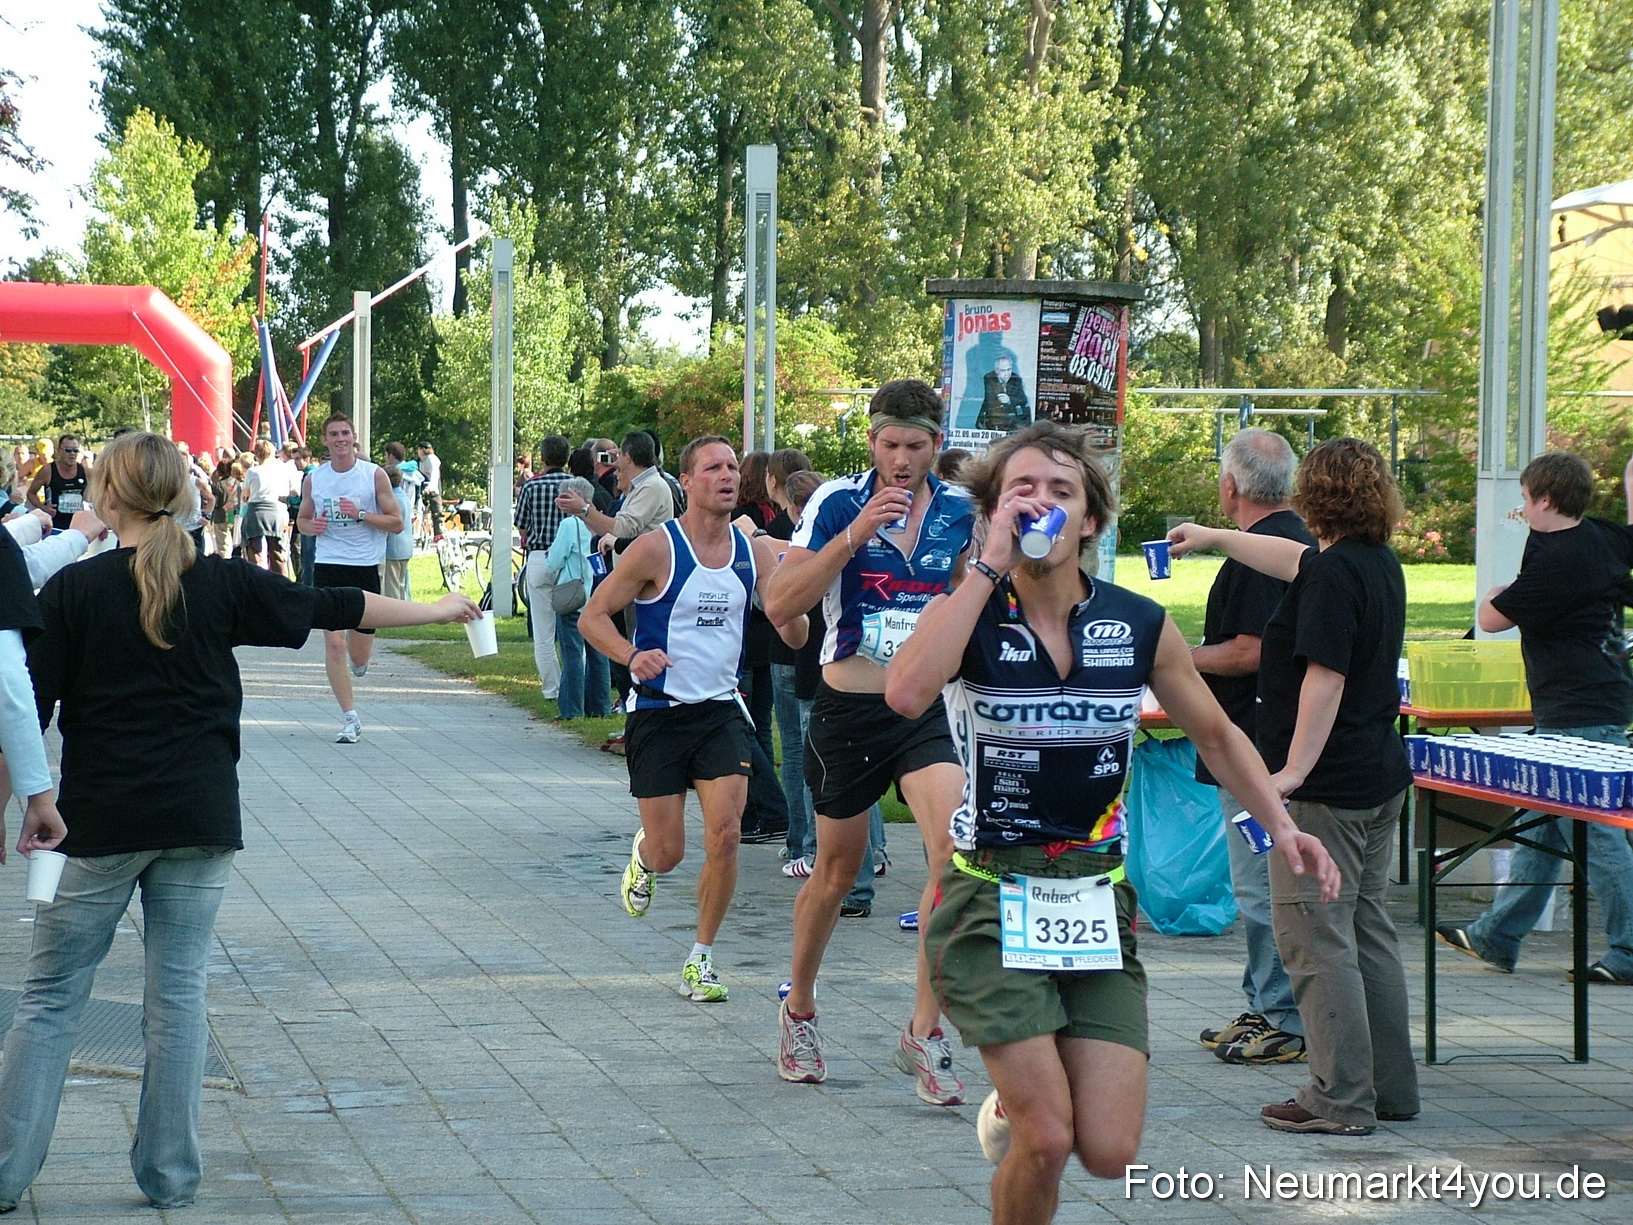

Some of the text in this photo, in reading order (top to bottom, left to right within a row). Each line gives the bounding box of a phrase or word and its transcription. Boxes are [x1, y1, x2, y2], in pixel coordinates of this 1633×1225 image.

[964, 304, 993, 317] Bruno
[957, 312, 1013, 342] Jonas
[1069, 353, 1116, 392] 08.09.07
[718, 592, 730, 600] LINE
[696, 616, 726, 627] PowerBar
[885, 616, 917, 631] Manfre
[1083, 657, 1134, 667] SHIMANO
[974, 699, 1135, 722] corratec
[989, 727, 1026, 736] LITE
[997, 750, 1025, 759] RST
[1093, 762, 1120, 775] SPD
[999, 779, 1020, 787] san
[993, 785, 1031, 794] marco
[1032, 886, 1082, 904] Robert
[1006, 909, 1109, 945] A 3325
[1075, 955, 1119, 964] PFLEIDERER
